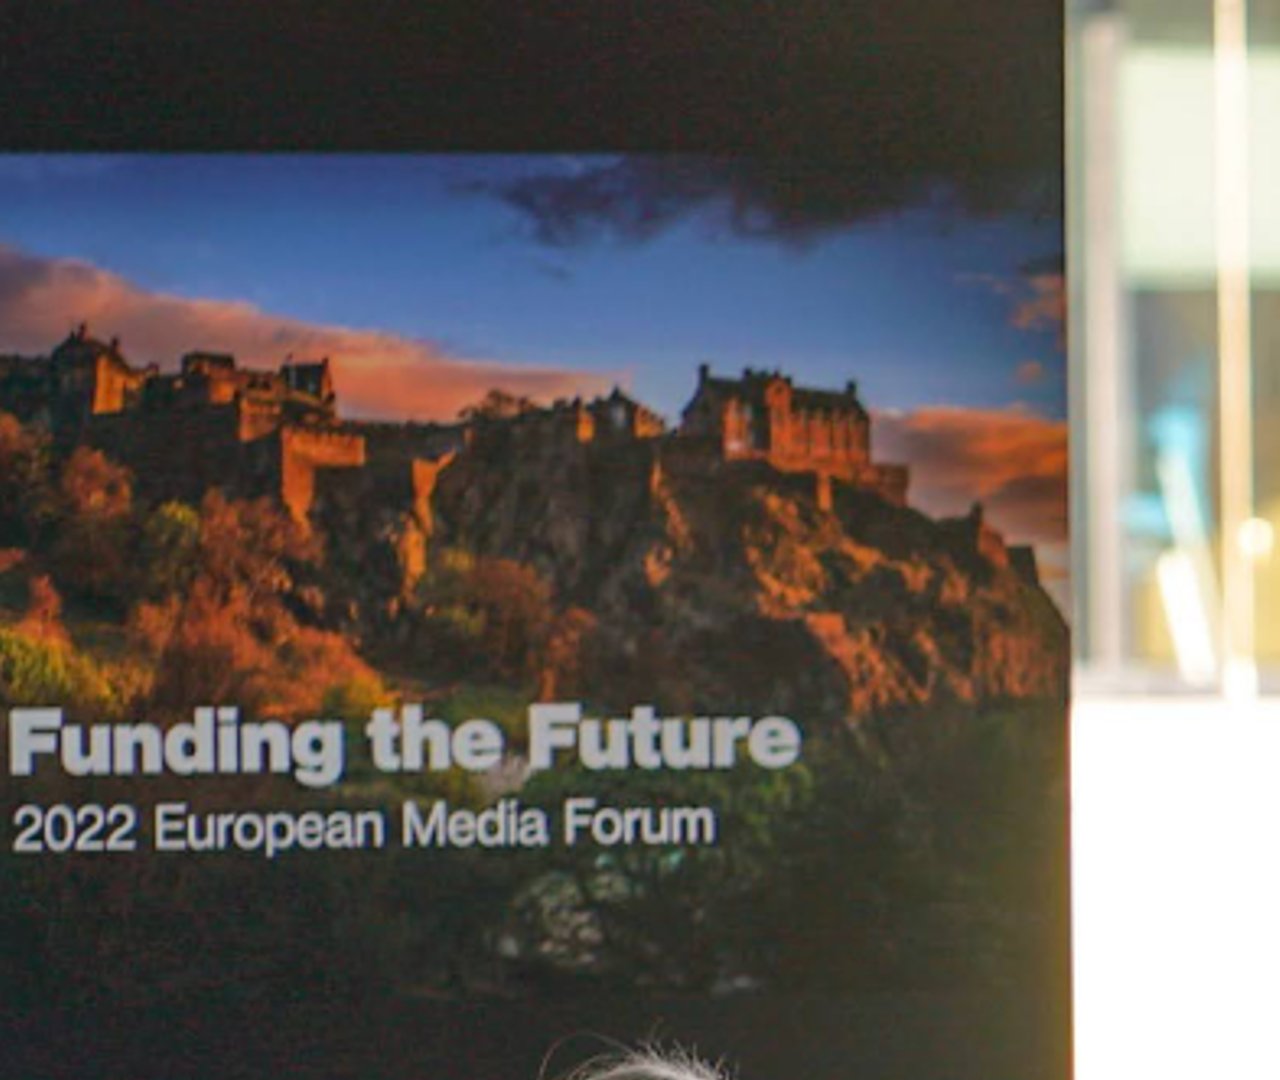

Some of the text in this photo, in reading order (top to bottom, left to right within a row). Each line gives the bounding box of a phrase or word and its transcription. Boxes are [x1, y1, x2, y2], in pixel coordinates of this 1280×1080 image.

[9, 703, 800, 786] Funding the Future
[14, 798, 714, 857] 2022 European Media Forum
